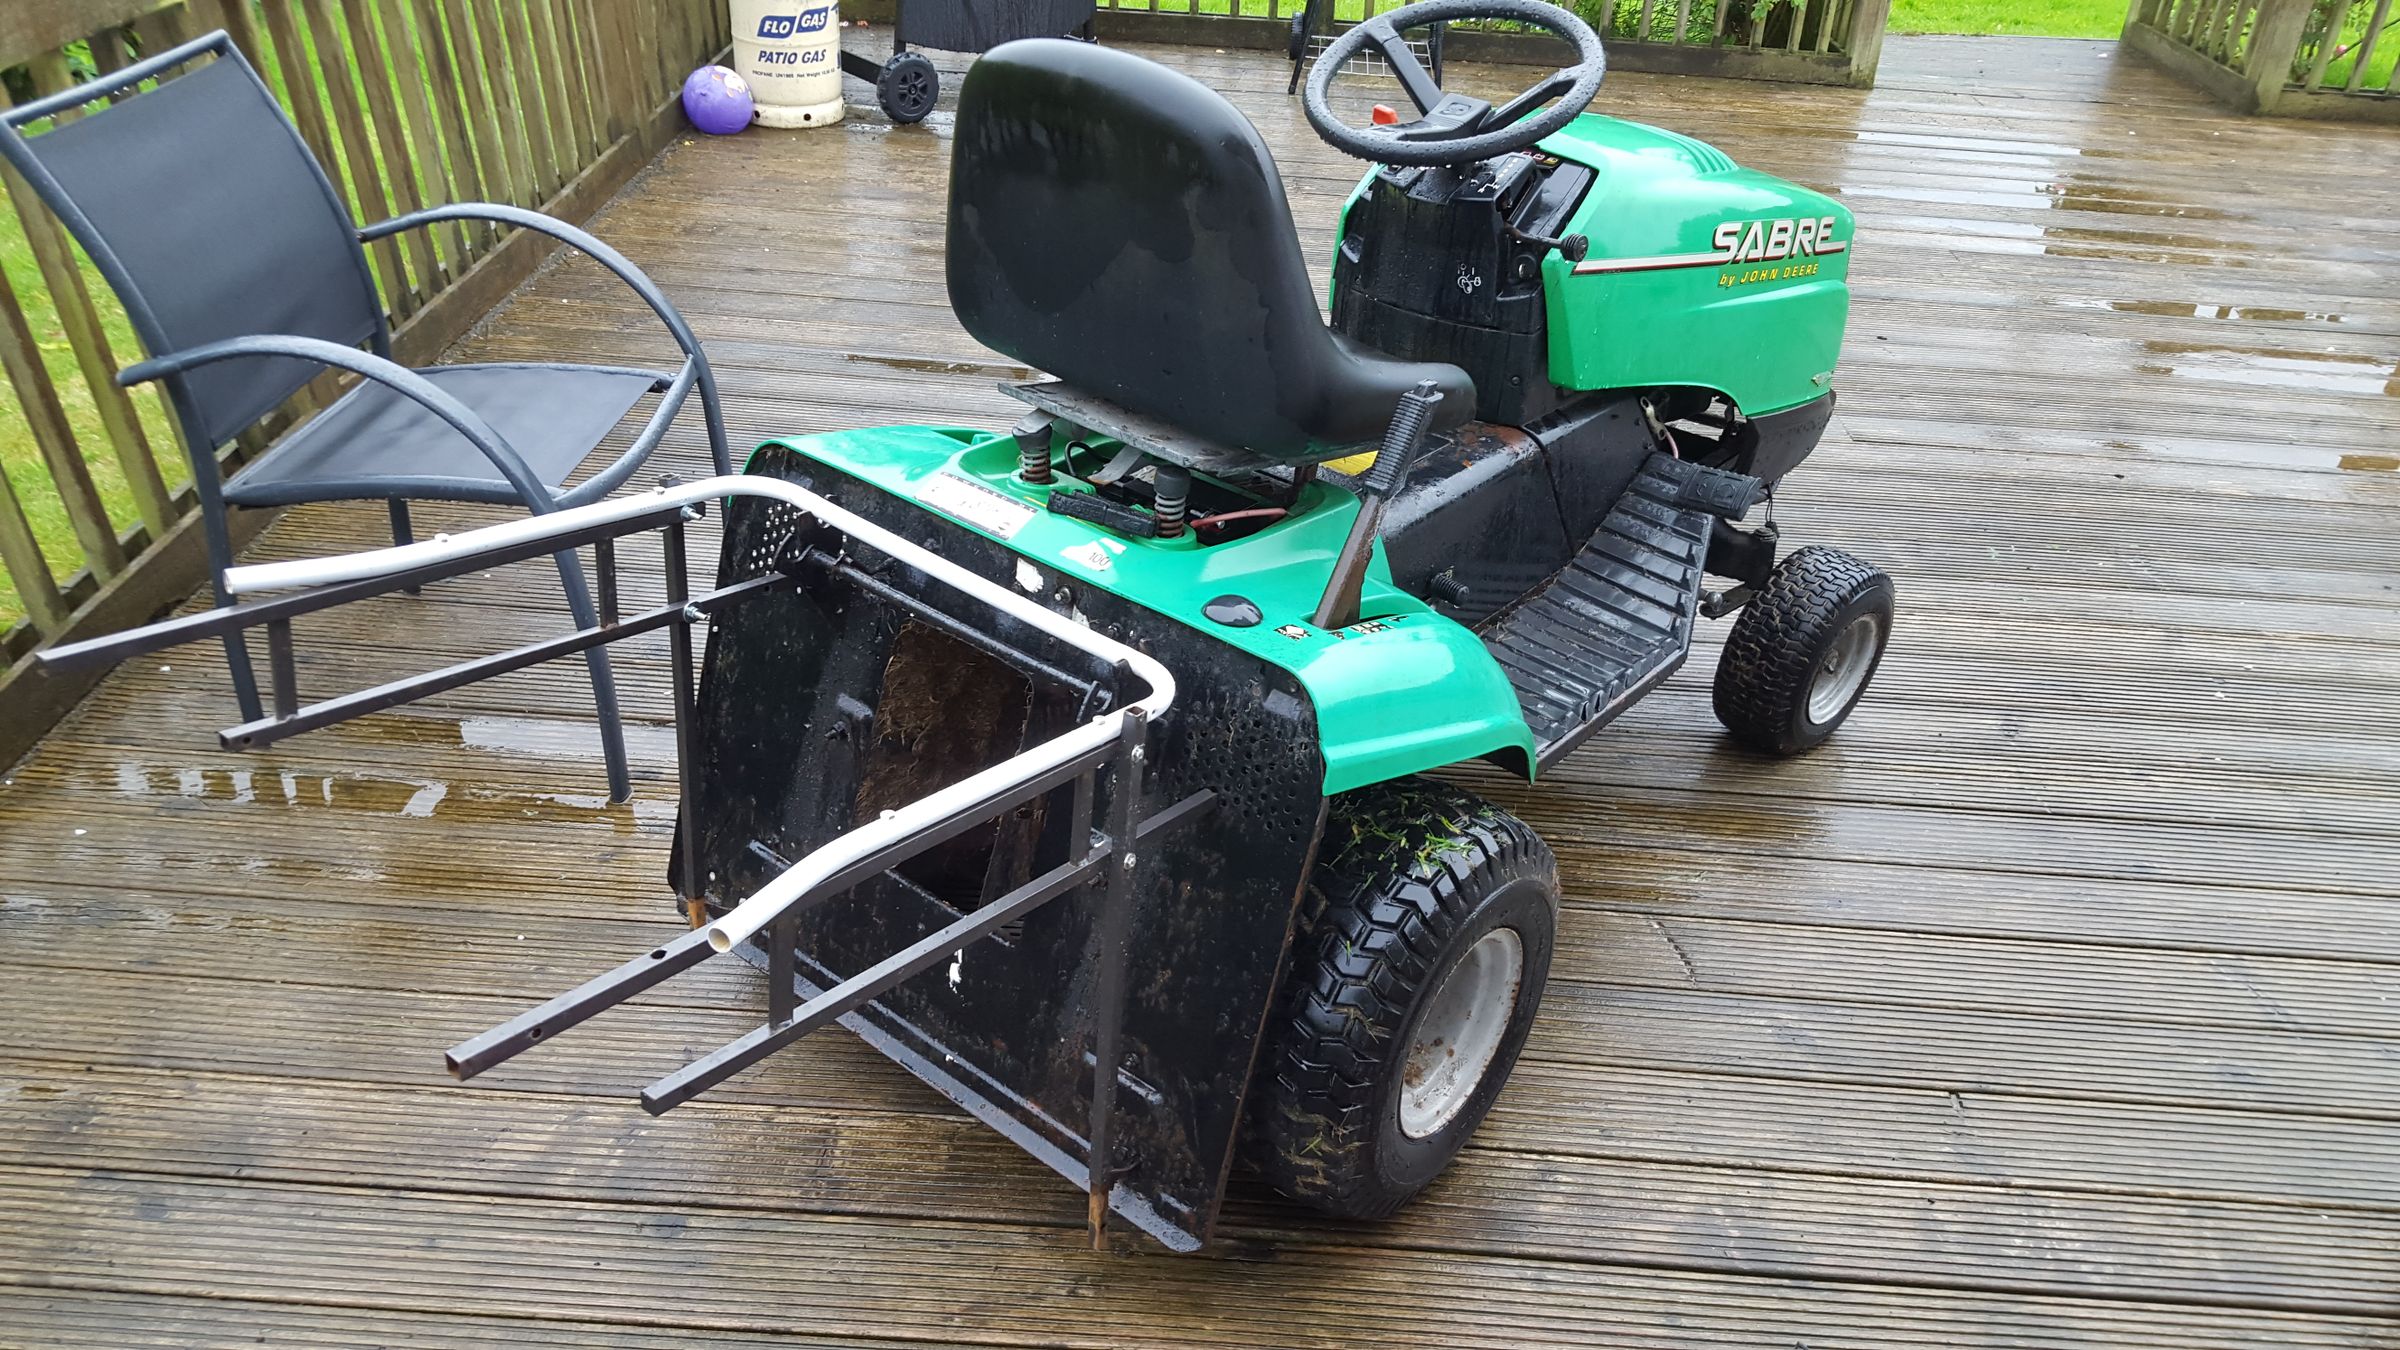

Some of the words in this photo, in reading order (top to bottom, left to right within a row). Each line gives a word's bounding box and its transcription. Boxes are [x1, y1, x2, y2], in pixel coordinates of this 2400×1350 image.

[763, 21, 790, 34] FLO
[801, 12, 826, 28] GAS
[758, 50, 797, 64] PATIO
[802, 49, 826, 64] GAS
[1712, 216, 1846, 264] SABRE
[1719, 273, 1736, 288] by
[1740, 268, 1779, 284] JOHN
[1783, 263, 1819, 279] DEERE
